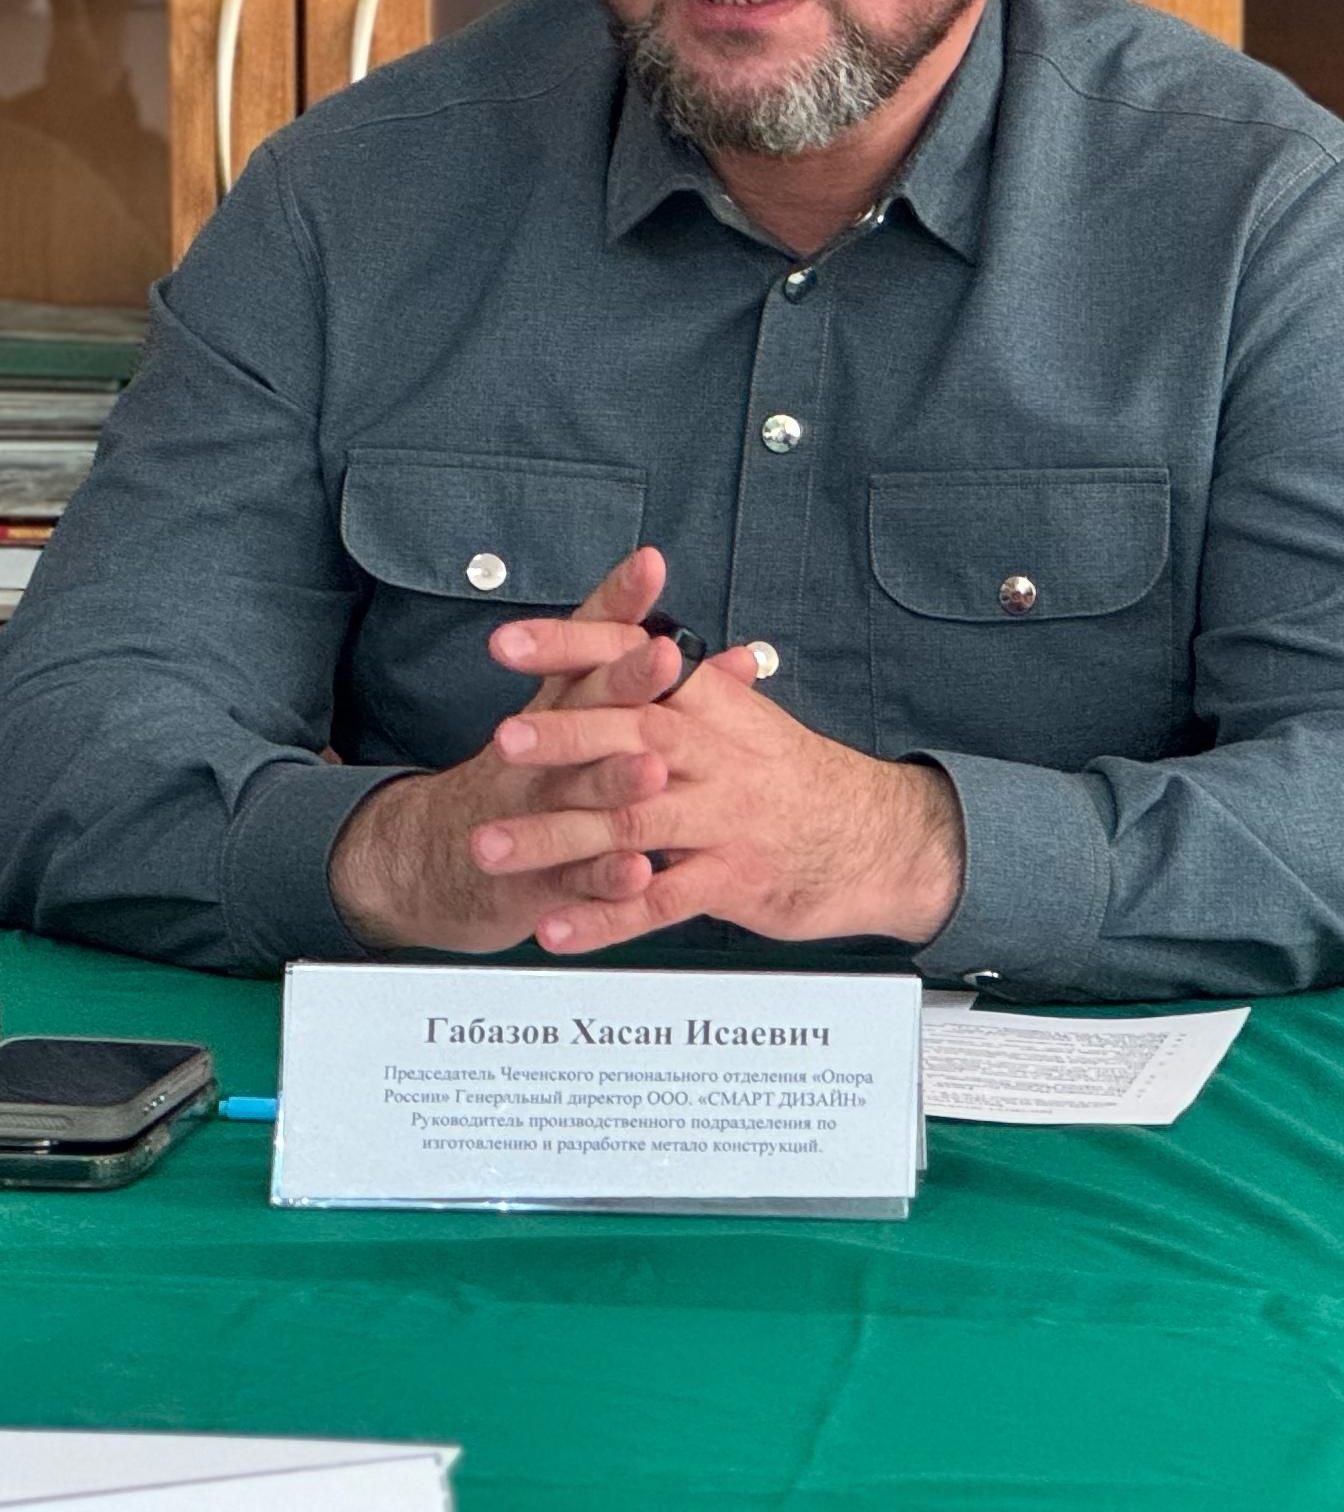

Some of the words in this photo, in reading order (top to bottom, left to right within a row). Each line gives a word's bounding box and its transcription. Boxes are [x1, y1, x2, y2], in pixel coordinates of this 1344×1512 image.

[424, 1017, 560, 1045] Габазов
[570, 1018, 672, 1045] Хасан
[684, 1019, 830, 1047] Исаевич
[383, 1065, 496, 1085] Председатель
[500, 1066, 594, 1083] Чеченского
[598, 1068, 718, 1086] регионального
[722, 1070, 807, 1086] отделения
[812, 1069, 874, 1087] «Опора
[383, 1088, 450, 1104] России»
[455, 1088, 563, 1108] Генеральный
[566, 1091, 642, 1109] директор
[698, 1091, 772, 1107] «СМАРТ
[778, 1088, 867, 1109] ДИЗАЙН»
[410, 1111, 524, 1130] Руководитель
[528, 1115, 686, 1132] производственного
[690, 1117, 811, 1133] подразделения
[817, 1118, 837, 1130] по
[422, 1137, 538, 1151] изготовлению
[542, 1139, 552, 1151] и
[556, 1136, 646, 1155] разработке
[650, 1140, 707, 1152] метало
[712, 1139, 823, 1156] конструкций.
